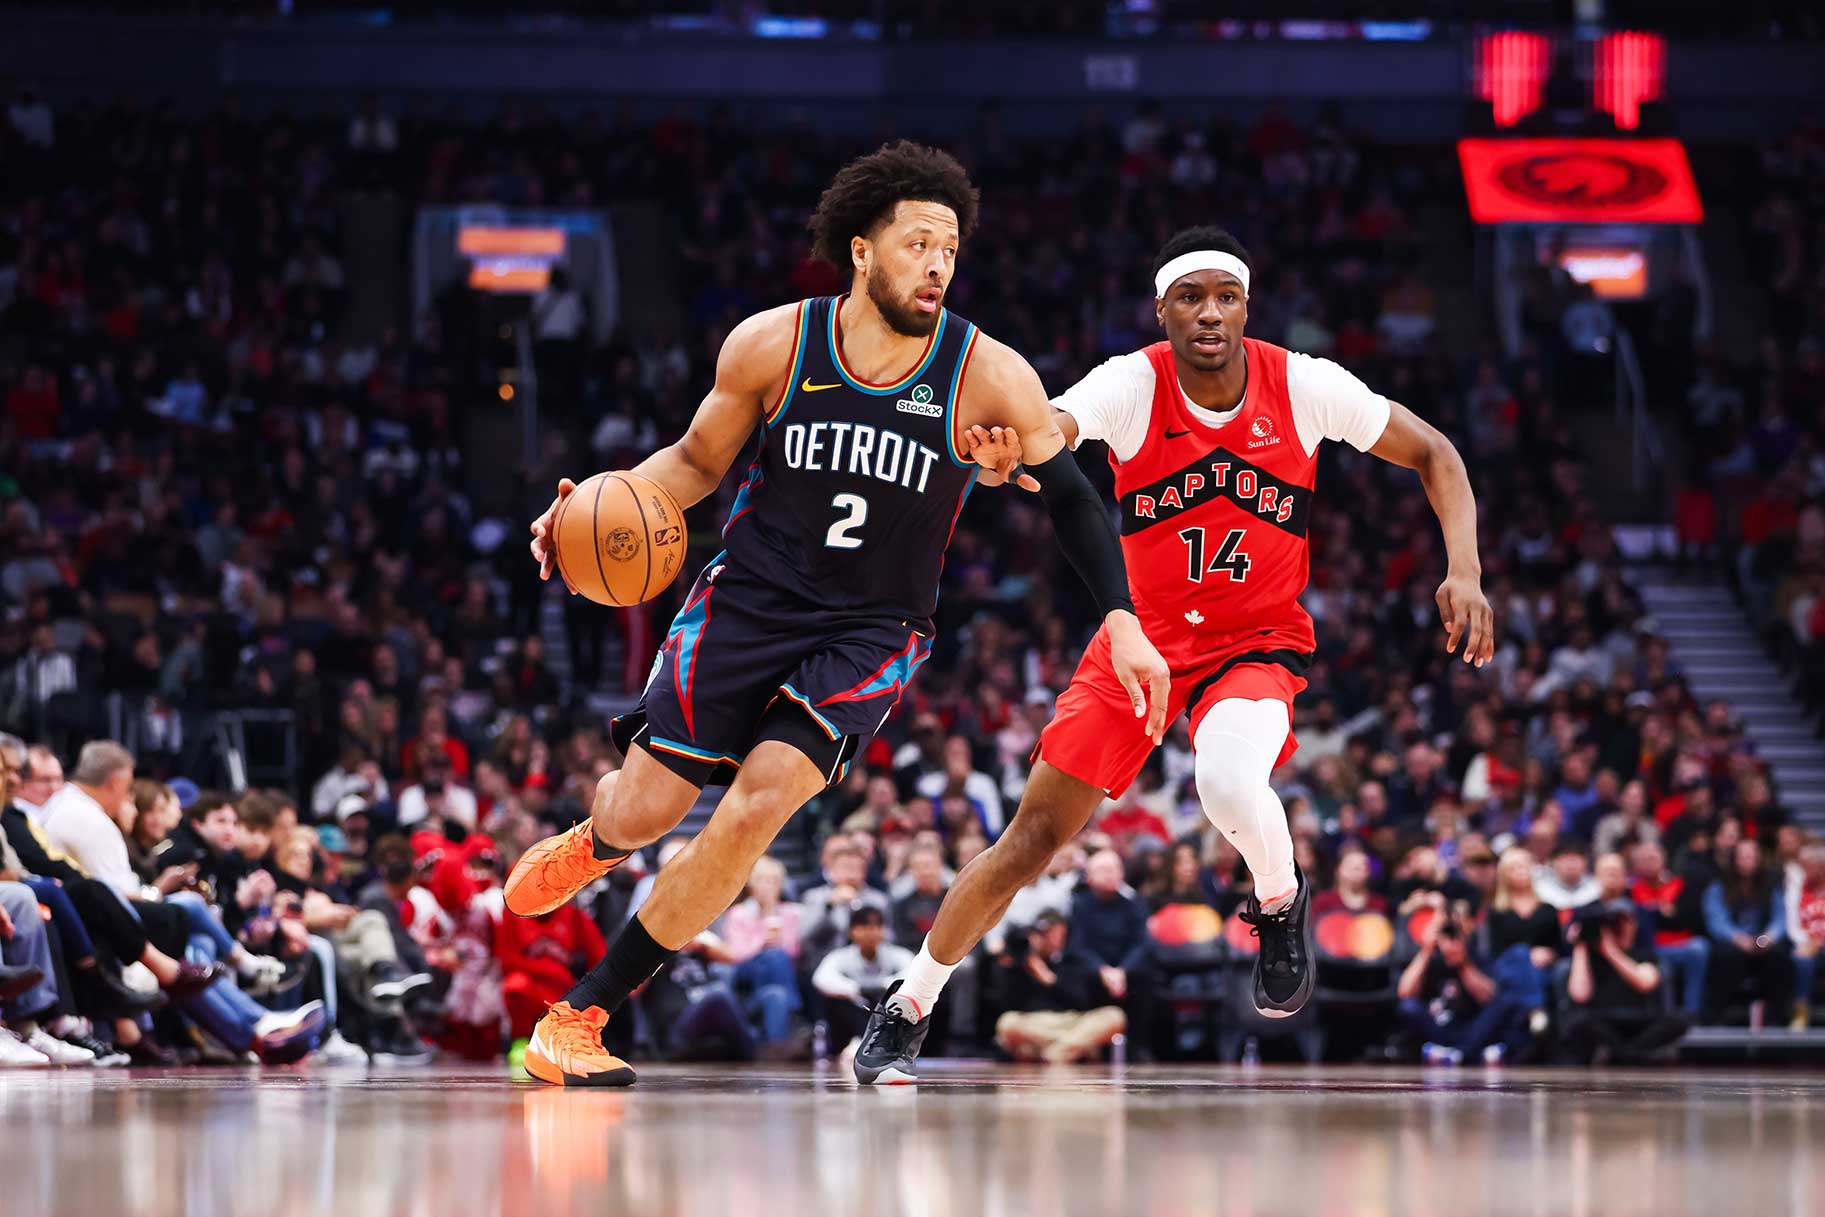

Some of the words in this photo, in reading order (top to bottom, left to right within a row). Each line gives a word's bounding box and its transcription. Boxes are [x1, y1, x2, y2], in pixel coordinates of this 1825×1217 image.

[898, 401, 941, 416] StockX
[784, 420, 940, 494] DETROIT
[1248, 440, 1265, 449] Sun
[1265, 435, 1281, 446] Life
[824, 492, 869, 548] 2
[1135, 462, 1294, 523] RAPTORS
[1178, 526, 1251, 583] 14
